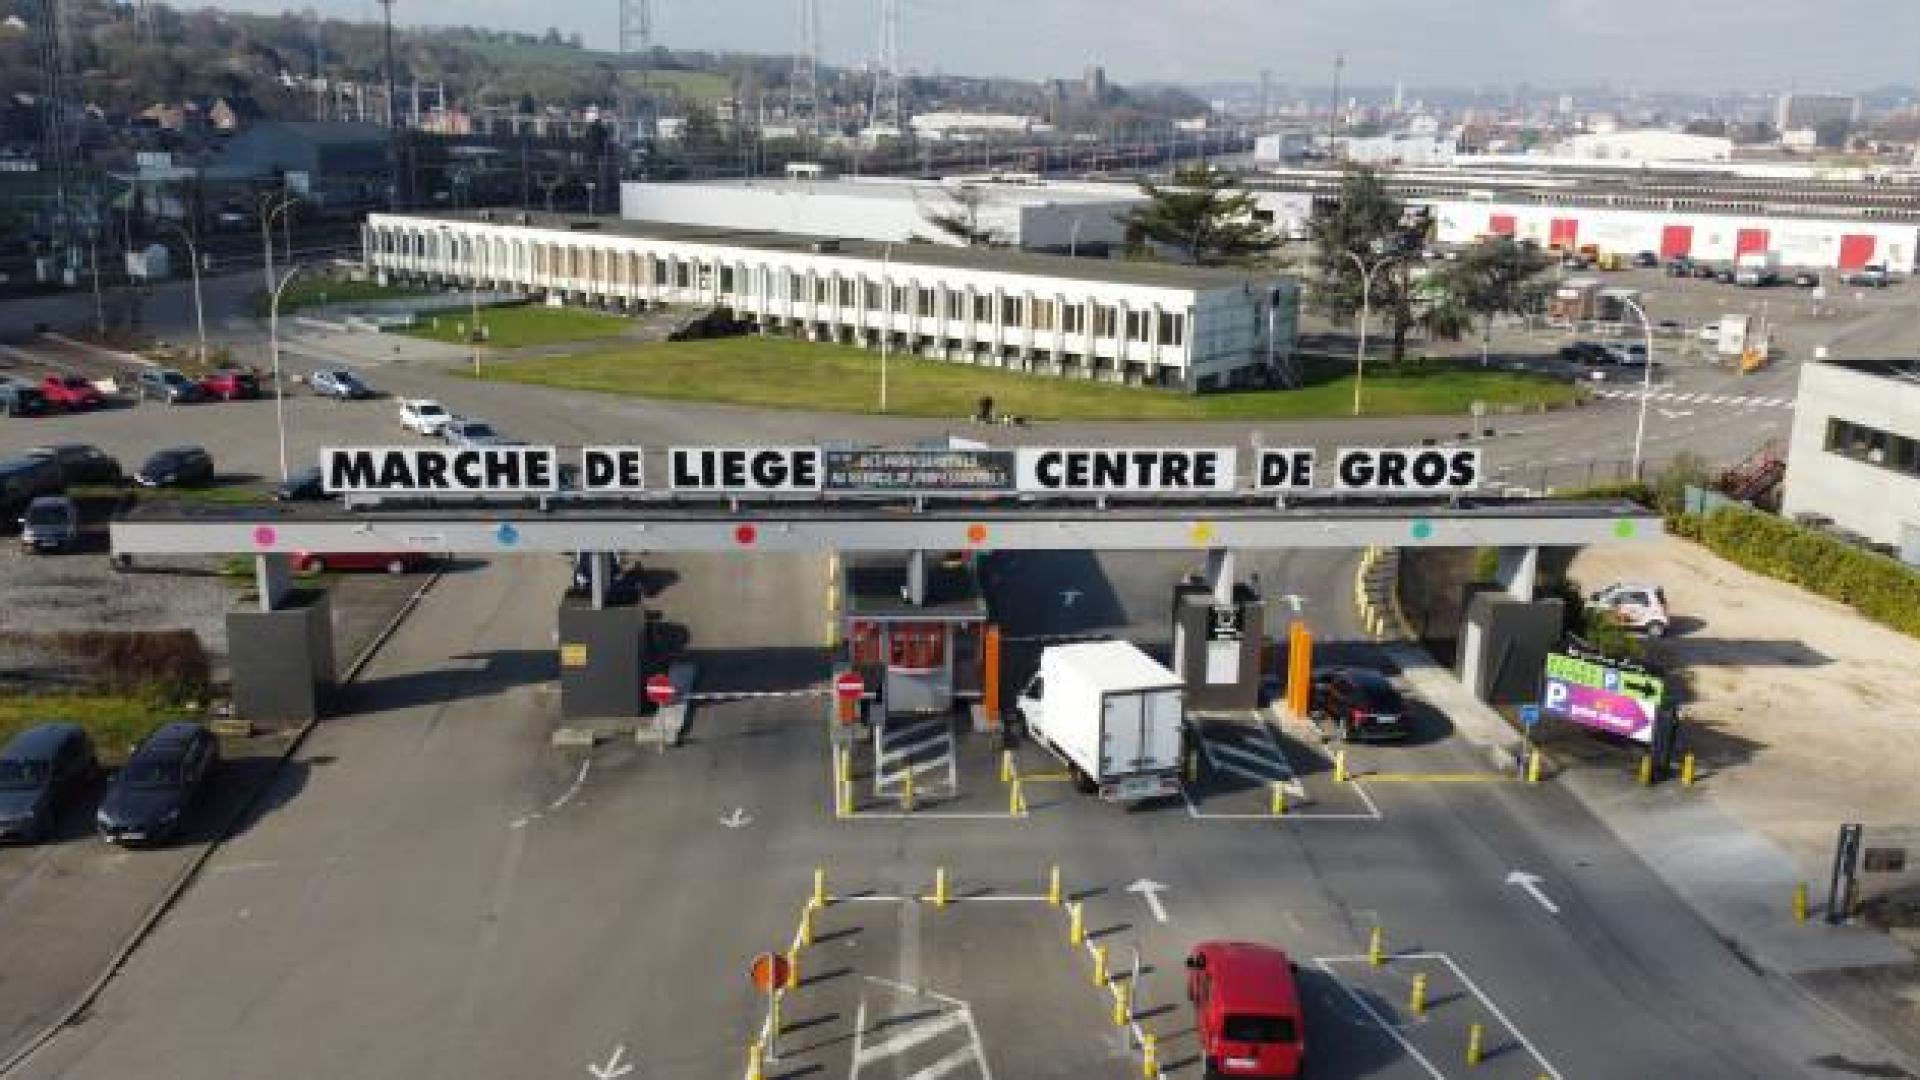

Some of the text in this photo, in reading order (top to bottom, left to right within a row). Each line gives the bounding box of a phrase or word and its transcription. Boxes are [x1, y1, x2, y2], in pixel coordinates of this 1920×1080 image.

[331, 451, 817, 487] MARCHE DE LIEGE
[1034, 451, 1476, 486] CENTRE DE GROS
[1547, 682, 1567, 709] P
